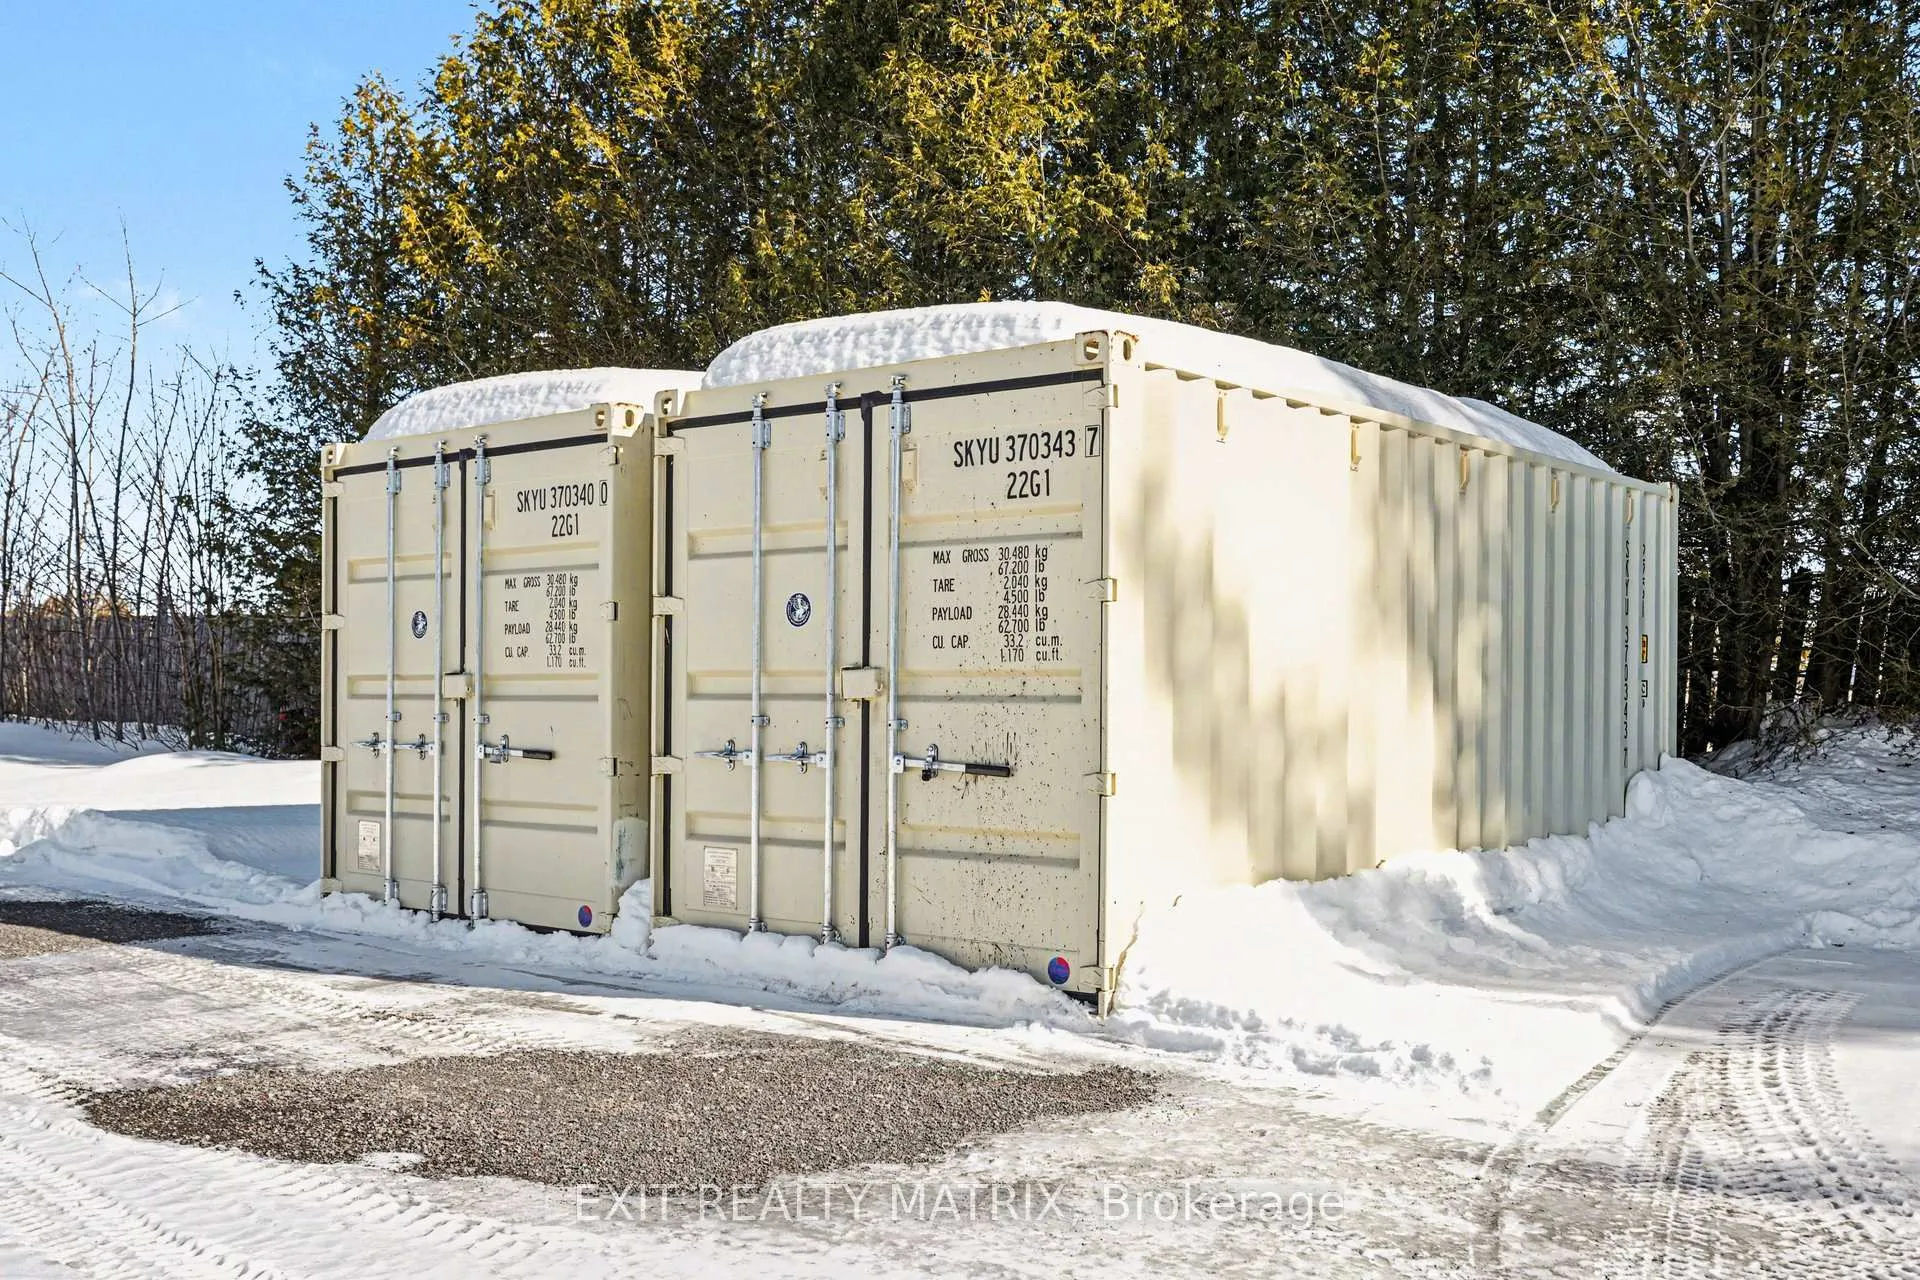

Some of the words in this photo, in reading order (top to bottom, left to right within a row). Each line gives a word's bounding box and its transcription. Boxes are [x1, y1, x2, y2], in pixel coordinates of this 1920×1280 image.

[953, 436, 1000, 468] SKYU
[1005, 430, 1076, 463] 370343
[1087, 427, 1098, 456] 7
[1007, 468, 1051, 500] 22G1
[517, 488, 546, 513] SKYU
[550, 482, 595, 509] 370340
[600, 481, 608, 505] 0
[551, 513, 580, 538] 22G1
[933, 550, 951, 564] MAX
[962, 548, 989, 563] GROSS
[1035, 544, 1048, 561] kg
[1035, 559, 1044, 573] lb
[505, 577, 516, 589] MAX
[524, 576, 540, 588] GROSS
[570, 573, 578, 587] kg
[933, 578, 955, 592] TARE
[1035, 574, 1047, 591] kg
[570, 585, 576, 597] lb
[1035, 589, 1045, 603] lb
[505, 600, 519, 612] TARE
[569, 597, 578, 612] kg
[932, 606, 973, 620] PAYLOAD
[1035, 604, 1048, 620] kg
[569, 608, 576, 620] lb
[505, 623, 530, 635] PAYLOAD
[569, 620, 578, 635] kg
[1035, 618, 1046, 632] lb
[569, 632, 576, 644] lb
[951, 634, 971, 649] CAP.
[1003, 633, 1024, 648] 33.2
[1035, 635, 1063, 647] cu.m.
